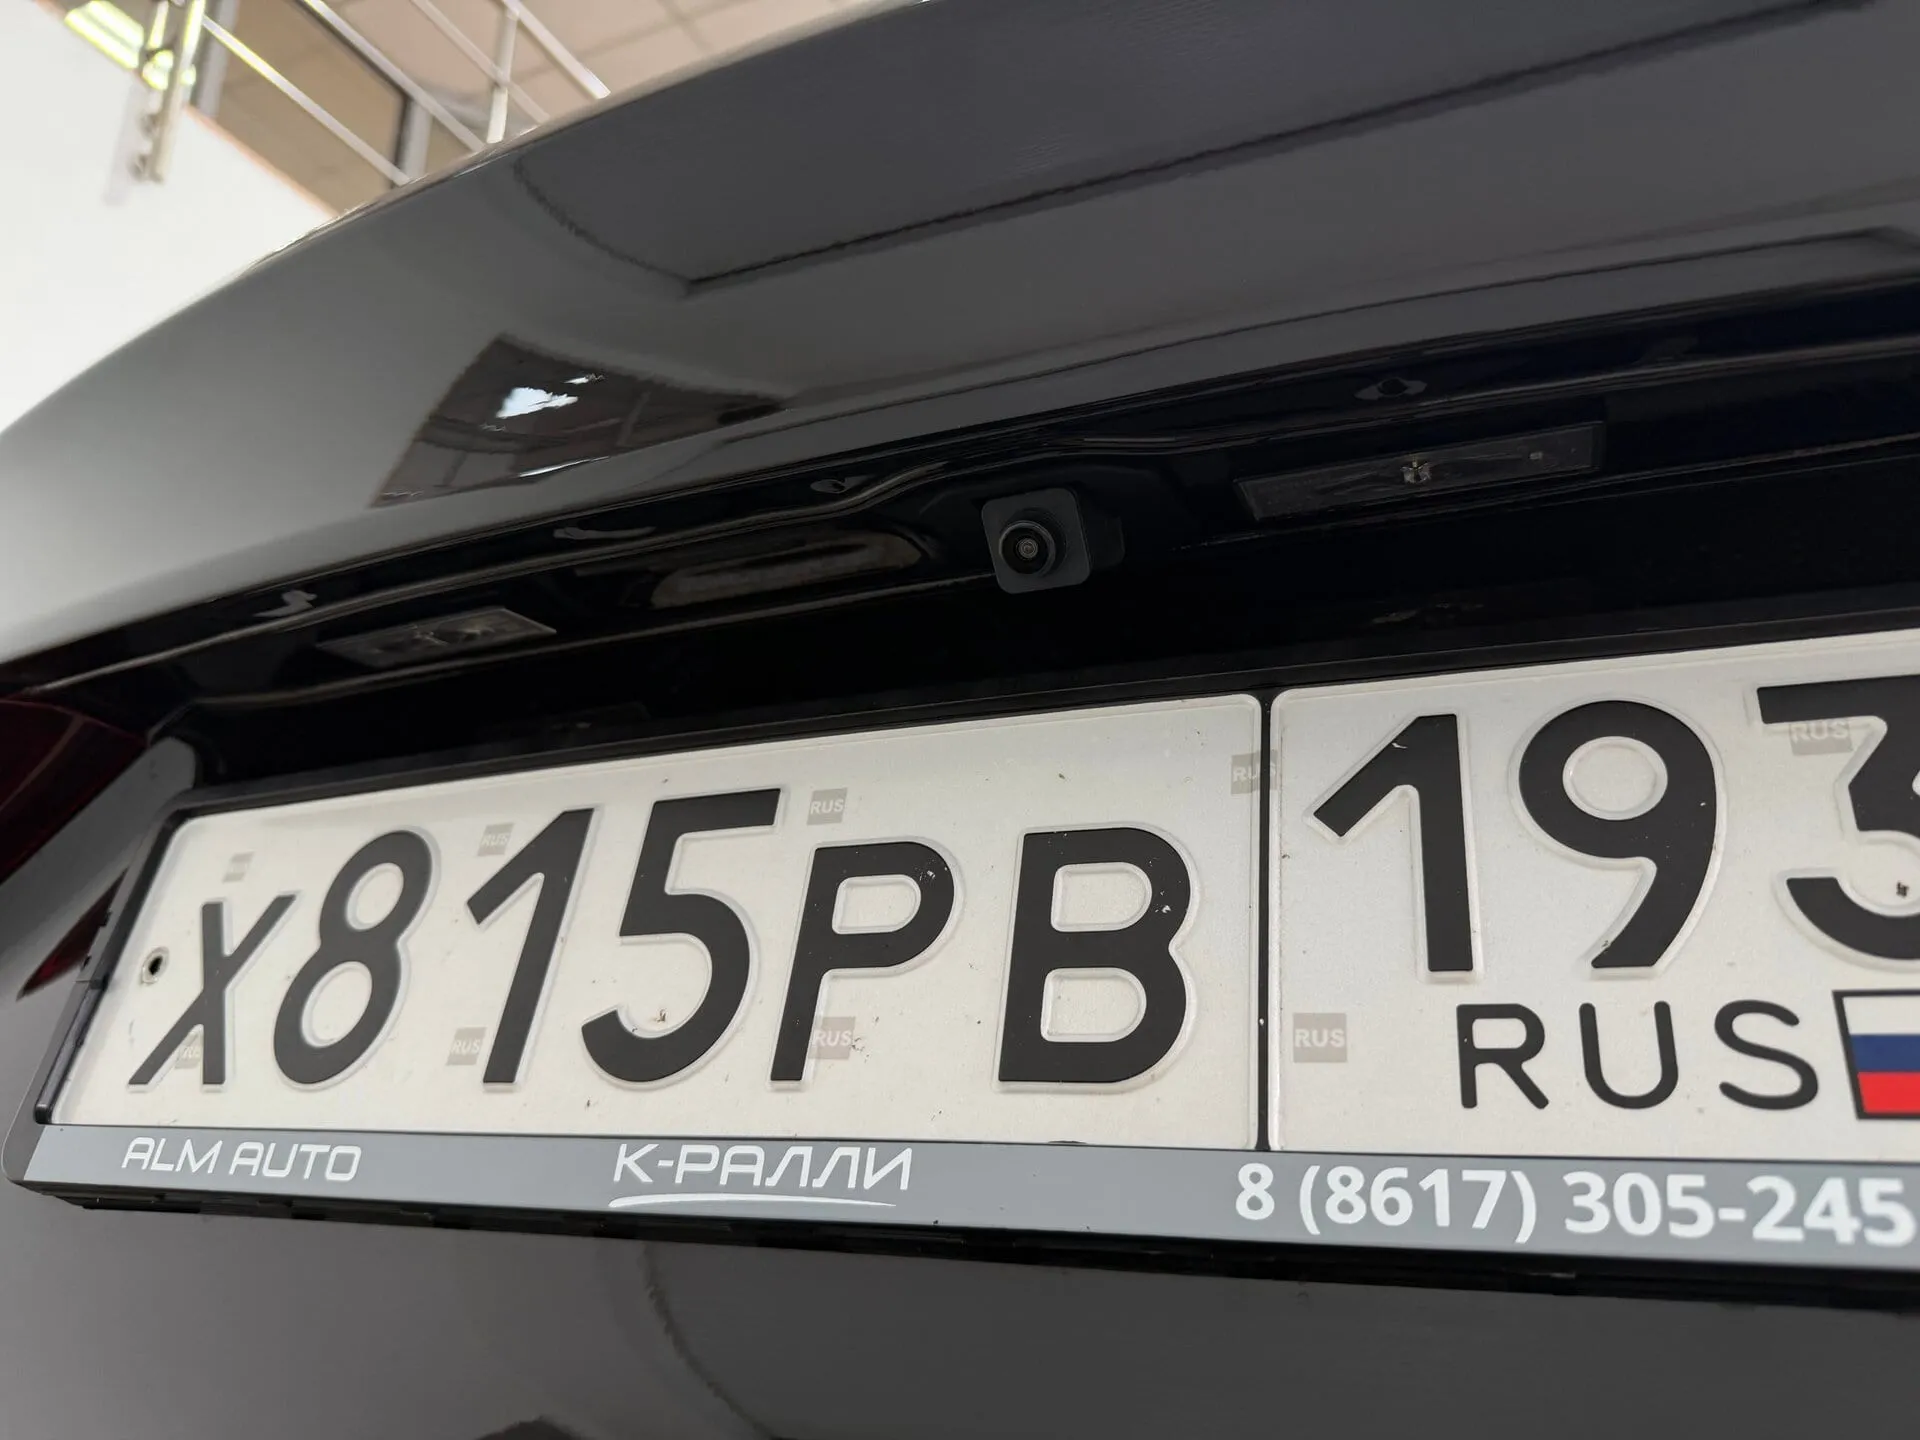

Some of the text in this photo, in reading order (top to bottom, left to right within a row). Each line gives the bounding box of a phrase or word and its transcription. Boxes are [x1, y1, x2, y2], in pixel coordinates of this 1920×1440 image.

[809, 799, 844, 815] RUS
[1313, 674, 1920, 972] 193
[1295, 1028, 1345, 1048] RUS
[1456, 1000, 1819, 1110] RUS
[121, 1137, 362, 1181] ALM AUTO
[1236, 1163, 1917, 1247] 8 (8617) 305-245
